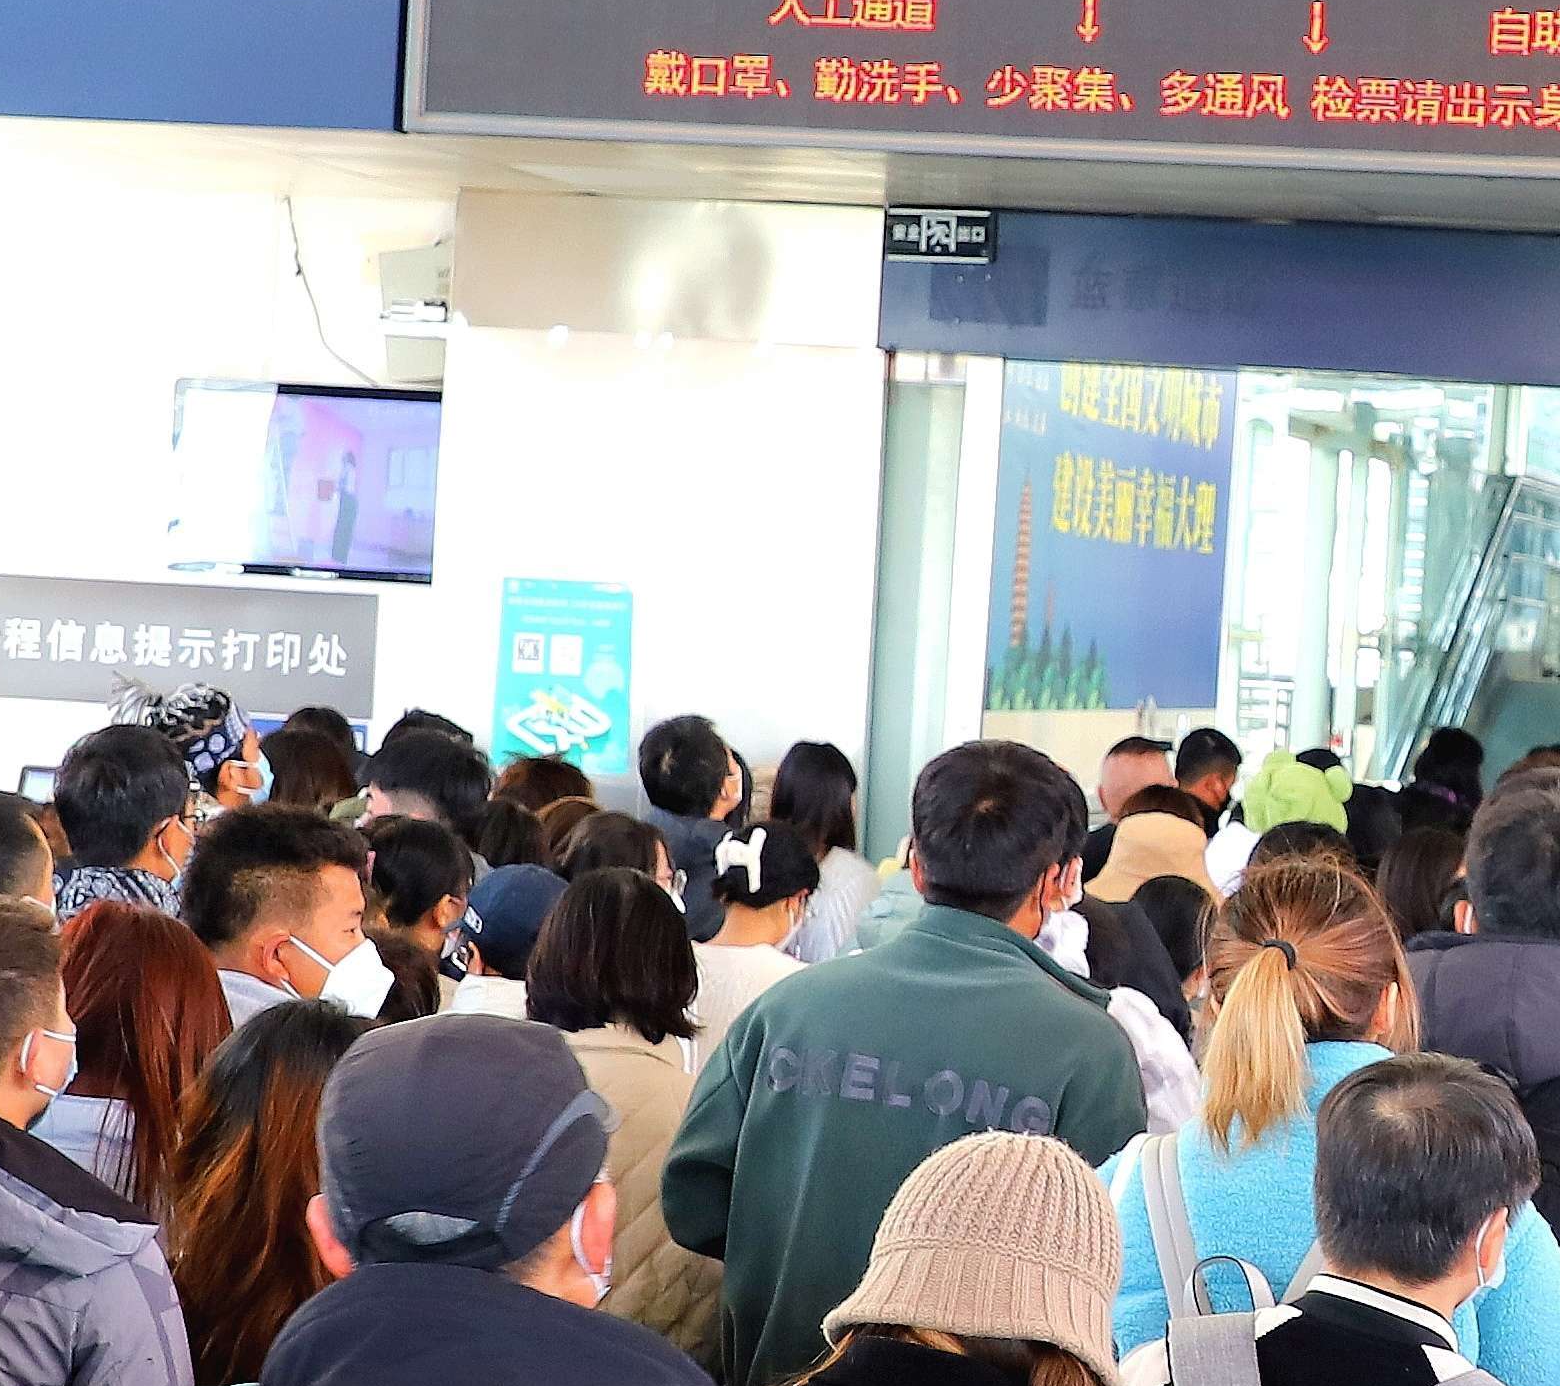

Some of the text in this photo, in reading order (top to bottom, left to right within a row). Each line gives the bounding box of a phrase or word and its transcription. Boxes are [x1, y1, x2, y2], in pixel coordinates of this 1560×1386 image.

[1051, 450, 1217, 555] 建设美丽幸福大理
